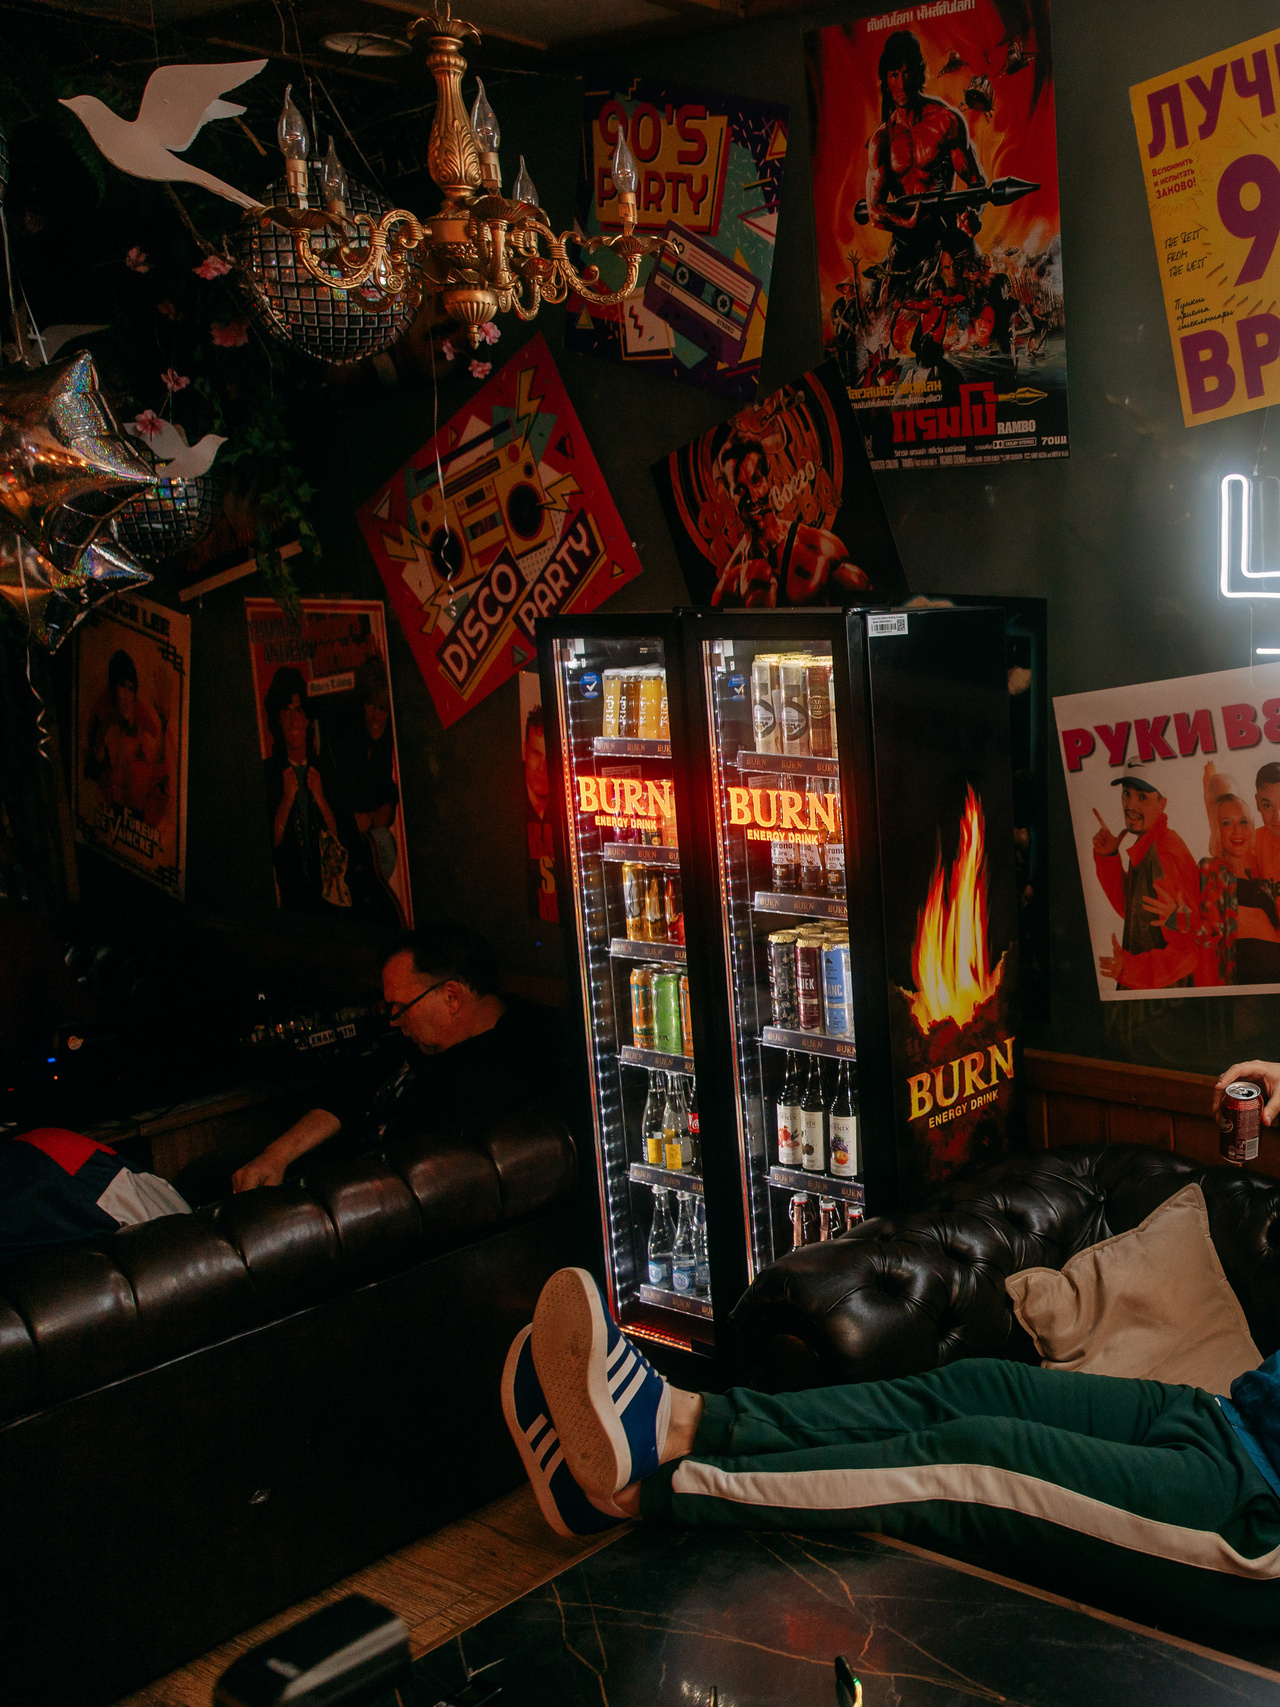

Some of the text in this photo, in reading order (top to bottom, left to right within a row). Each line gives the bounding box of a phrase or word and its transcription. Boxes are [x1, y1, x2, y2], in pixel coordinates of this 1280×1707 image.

[599, 100, 708, 165] 90'S
[1152, 158, 1193, 177] Вспомнить
[1153, 169, 1195, 188] и испытать
[1156, 177, 1196, 199] ЗАНОВО!
[597, 167, 708, 215] PRTY
[1164, 237, 1178, 249] THE
[1167, 249, 1188, 264] FROM
[1169, 264, 1183, 278] THE
[997, 419, 1036, 435] RAMBO
[518, 521, 592, 636] PARTY
[443, 563, 517, 683] DISCO
[627, 743, 645, 751] BURN
[1061, 709, 1216, 772] РУКИ
[746, 757, 767, 766] BURN
[781, 760, 802, 769] BURN
[577, 776, 671, 818] BURN
[727, 787, 836, 832] BURN
[595, 815, 657, 831] ENERGY DRINK
[747, 829, 819, 846] ENERGY DRINK
[760, 897, 779, 907] BURN
[793, 901, 815, 911] BURN
[768, 1032, 788, 1042] BURN
[802, 1038, 823, 1048] BURN
[906, 1036, 1015, 1122] BURN
[929, 1089, 999, 1128] ENERGY DRINK
[774, 1173, 862, 1198] BURN BURN BURN
